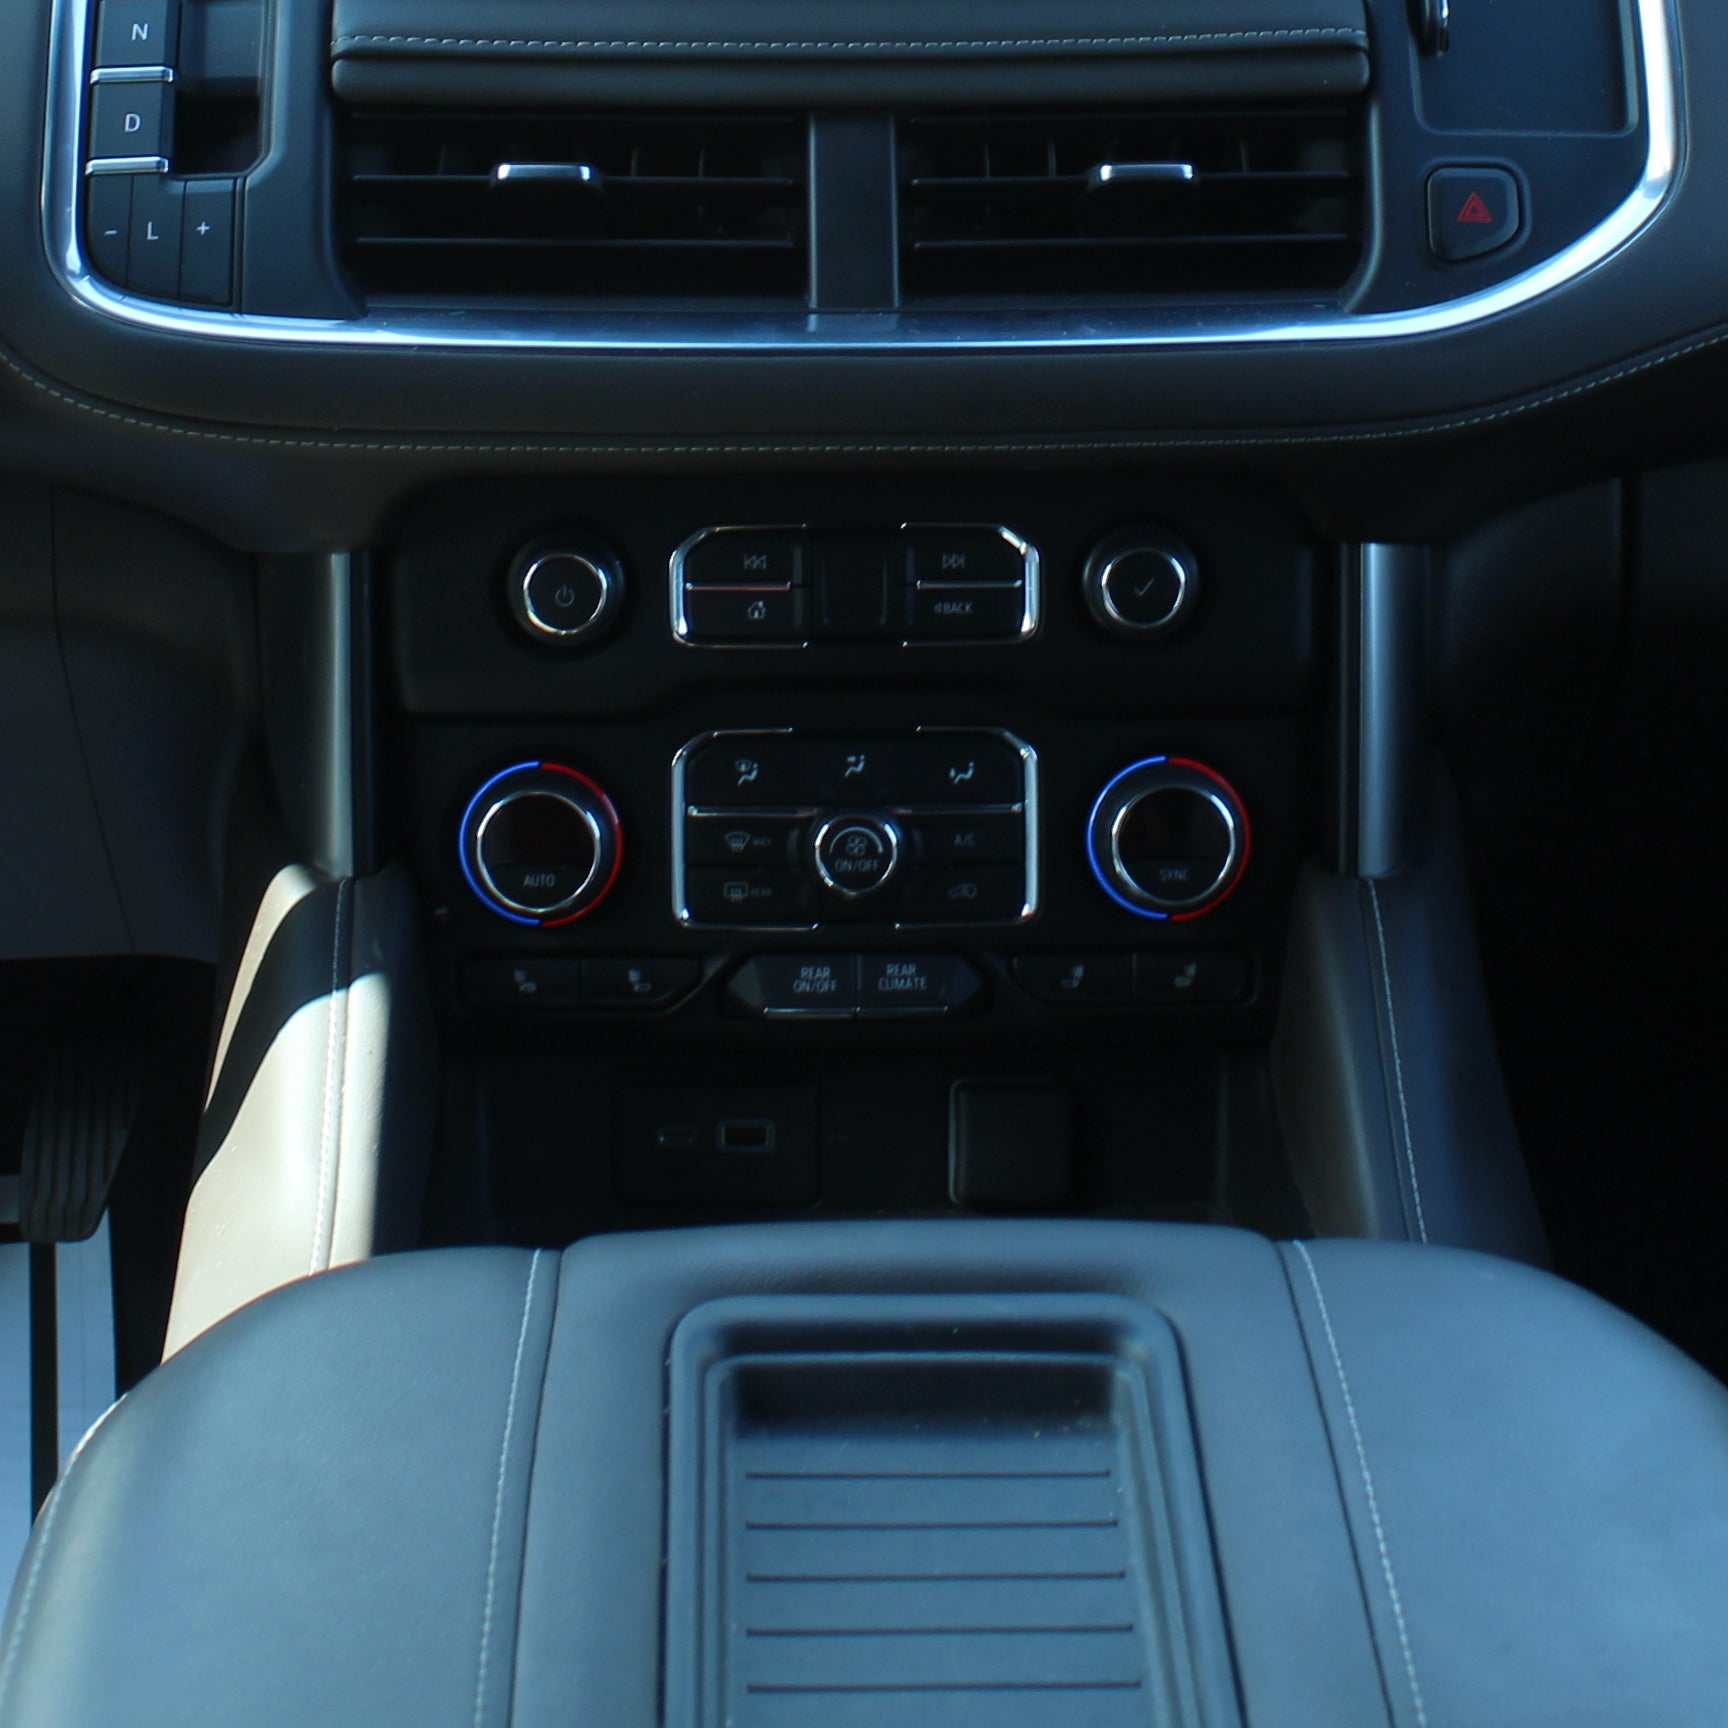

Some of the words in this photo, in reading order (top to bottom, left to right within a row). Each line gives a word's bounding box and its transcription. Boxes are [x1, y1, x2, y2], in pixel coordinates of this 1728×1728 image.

[130, 22, 150, 42] N
[123, 112, 142, 133] D
[146, 221, 160, 241] L
[942, 602, 974, 614] BACK
[953, 834, 976, 847] A/C
[833, 858, 880, 873] ON/OFF
[522, 872, 557, 888] AUTO
[1158, 868, 1191, 882] SYNC
[800, 965, 832, 980] REAR
[886, 963, 917, 978] REAR
[792, 979, 839, 994] ON/OFF
[877, 976, 928, 992] CLIMATE
